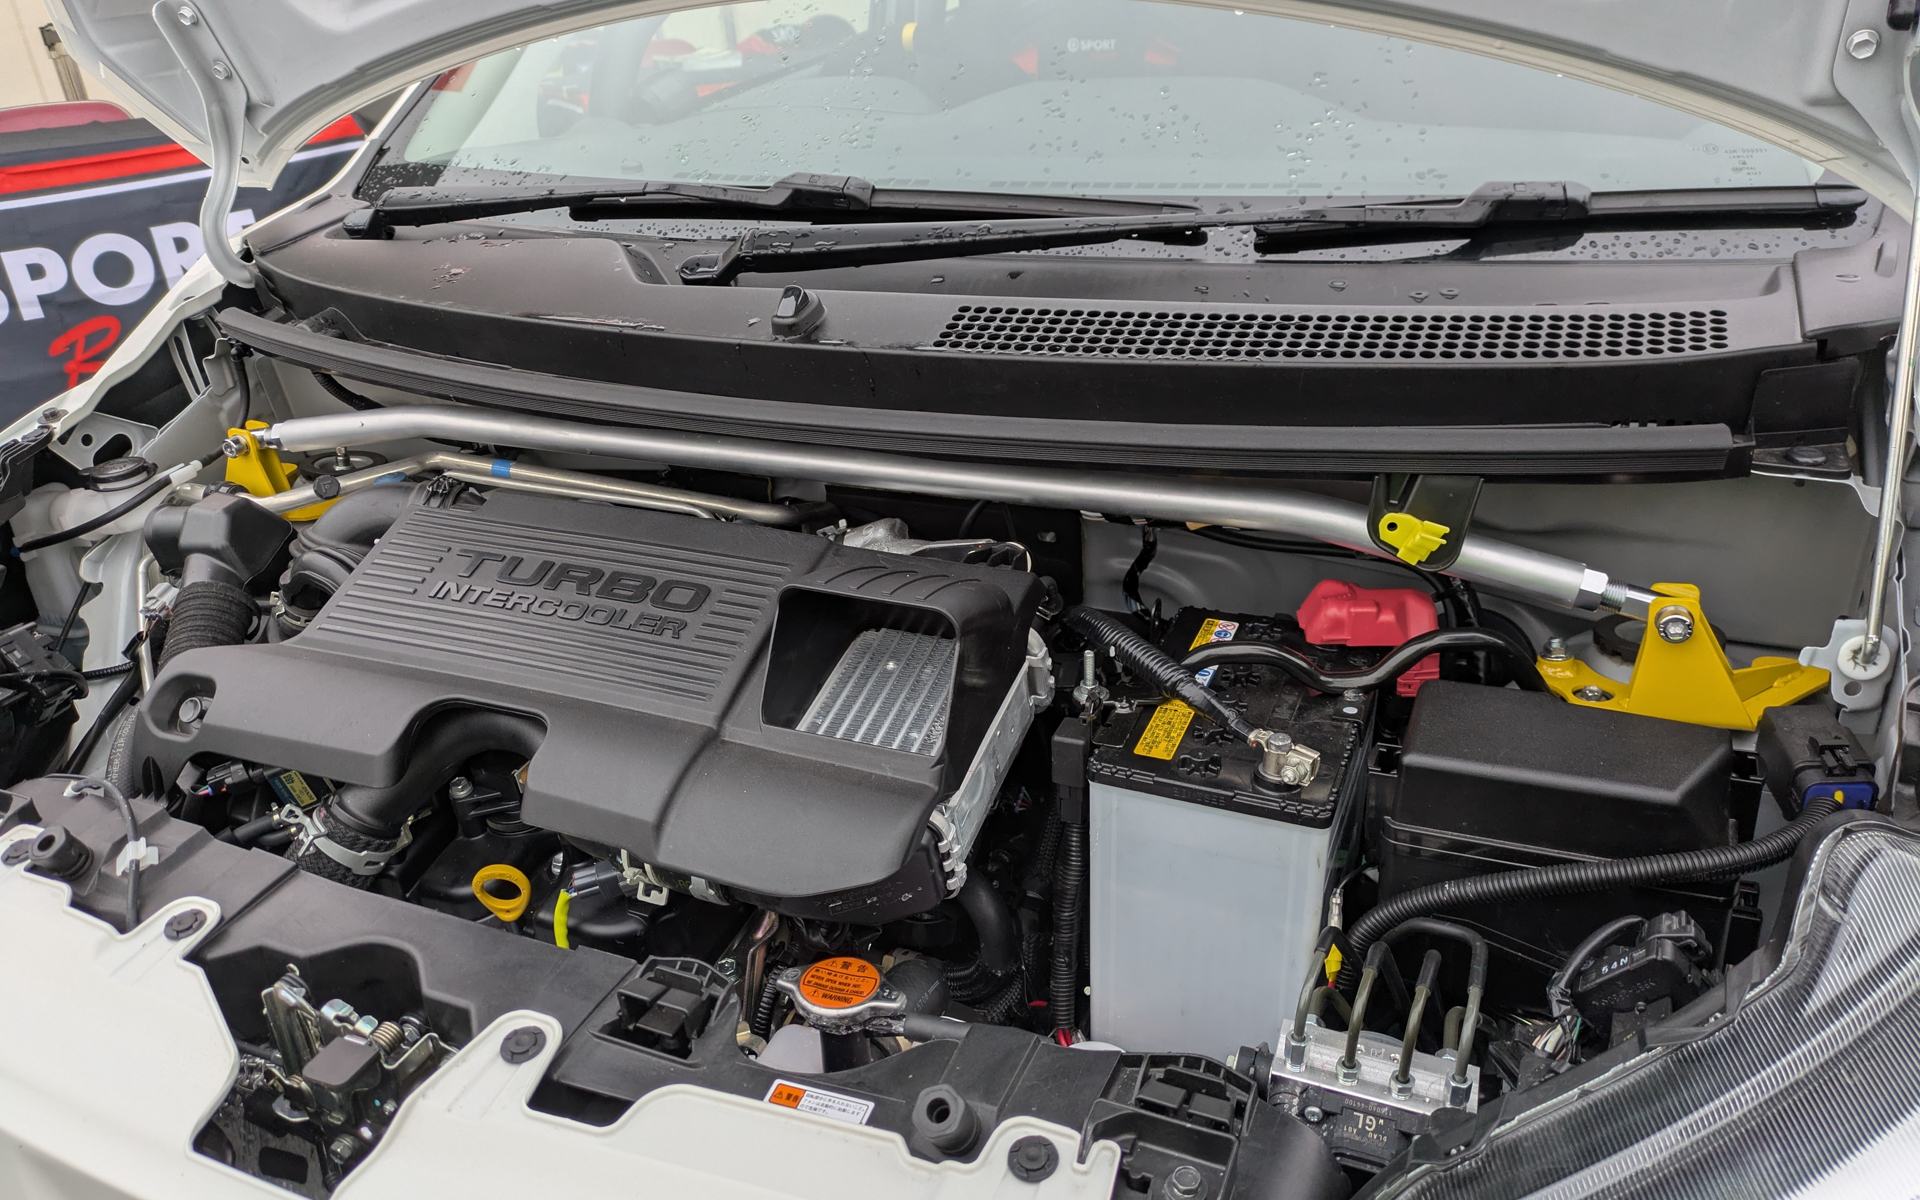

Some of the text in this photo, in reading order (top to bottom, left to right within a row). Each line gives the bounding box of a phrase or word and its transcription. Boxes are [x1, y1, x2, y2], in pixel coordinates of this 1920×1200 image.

[0, 209, 256, 325] POR
[428, 580, 687, 639] INTERCOOLER
[456, 549, 711, 613] TURBO
[821, 992, 853, 1004] WARNING
[1353, 1111, 1376, 1132] GL
